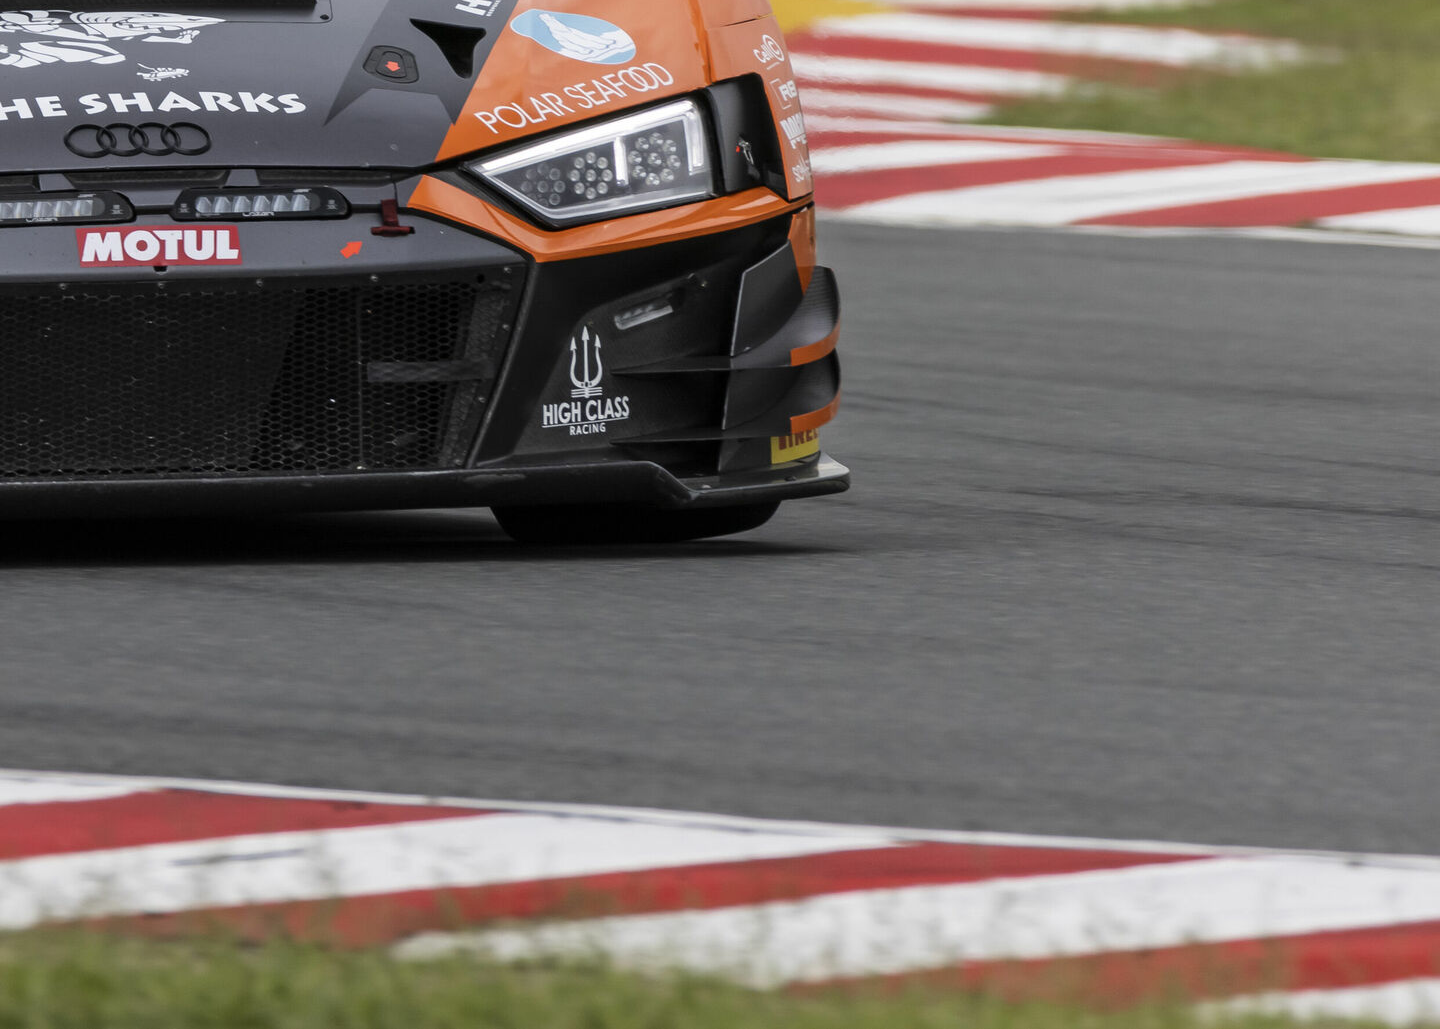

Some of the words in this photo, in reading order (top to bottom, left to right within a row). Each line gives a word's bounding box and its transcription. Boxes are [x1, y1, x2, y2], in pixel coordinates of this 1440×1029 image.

[79, 90, 307, 115] SHARKS
[474, 92, 575, 134] POLAR
[563, 62, 674, 109] SEAFOOD
[81, 230, 240, 263] MOTUL
[543, 399, 581, 426] HIGH
[586, 395, 630, 419] CLASS
[569, 422, 607, 436] RACING
